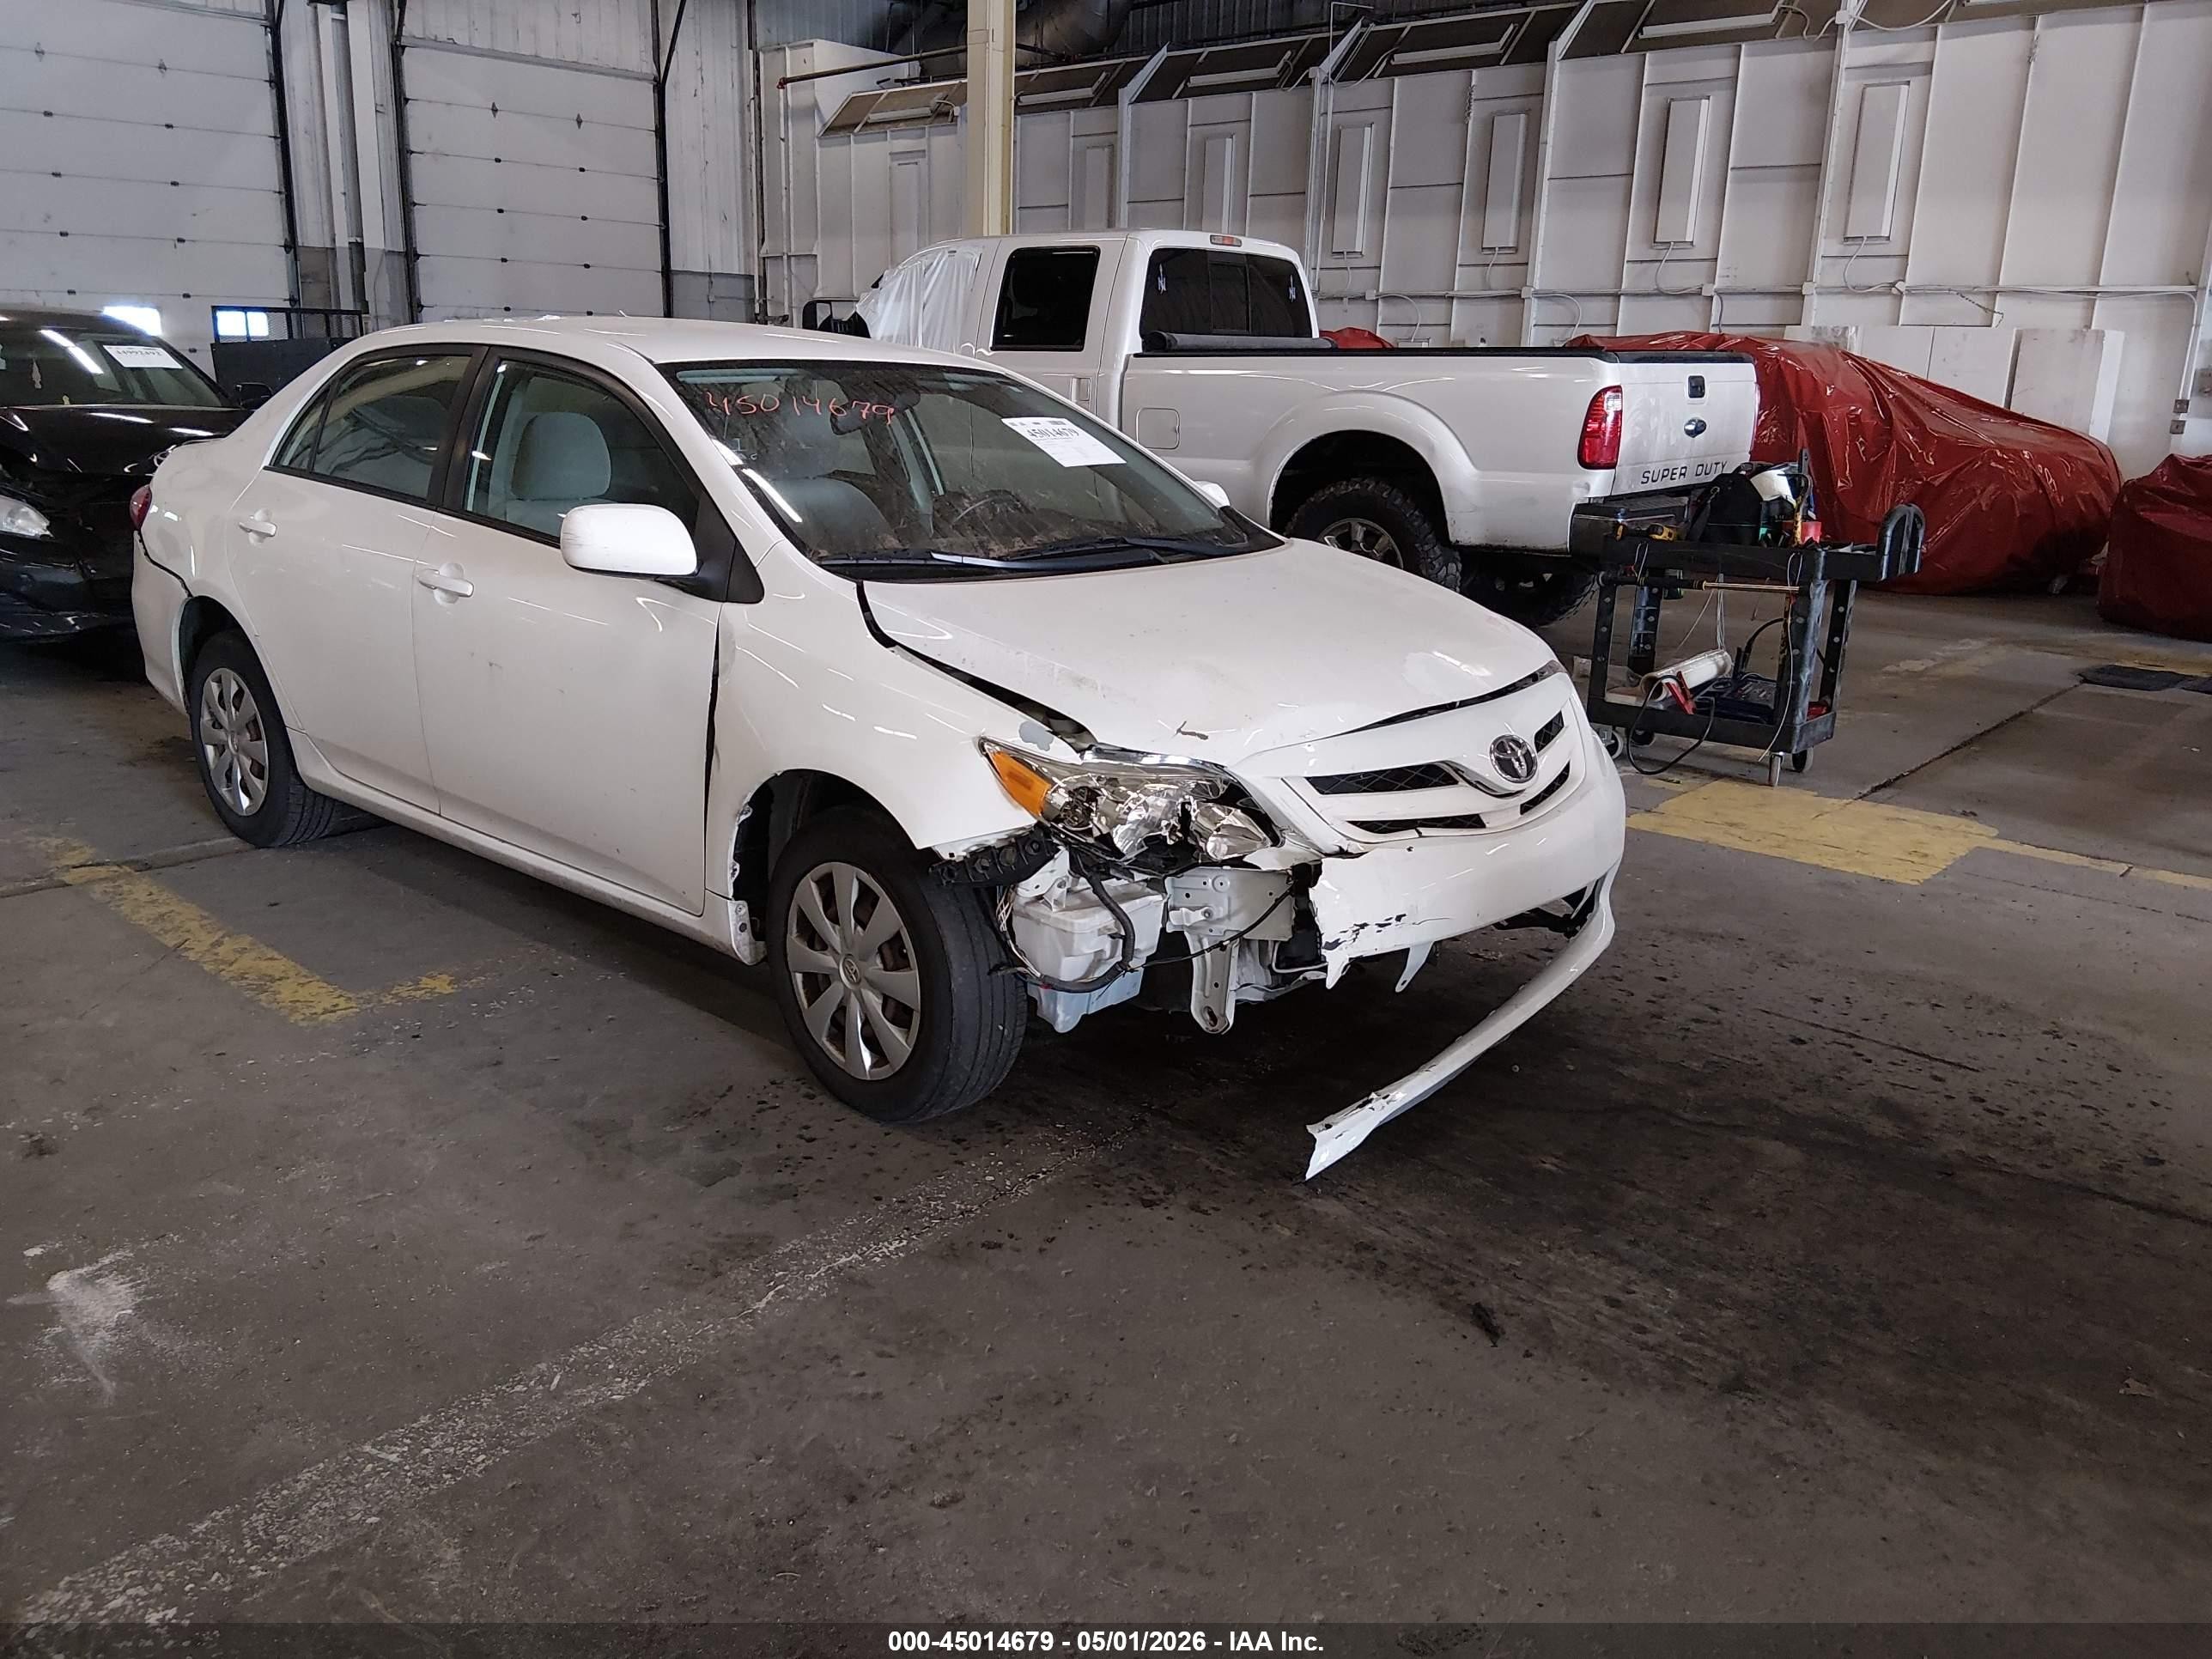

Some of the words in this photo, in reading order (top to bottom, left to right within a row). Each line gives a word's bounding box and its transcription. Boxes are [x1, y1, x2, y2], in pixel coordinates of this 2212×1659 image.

[706, 392, 895, 425] 45014679
[1026, 428, 1079, 439] 45014679
[1640, 465, 1688, 485] SUPER
[1694, 460, 1728, 477] DUTY
